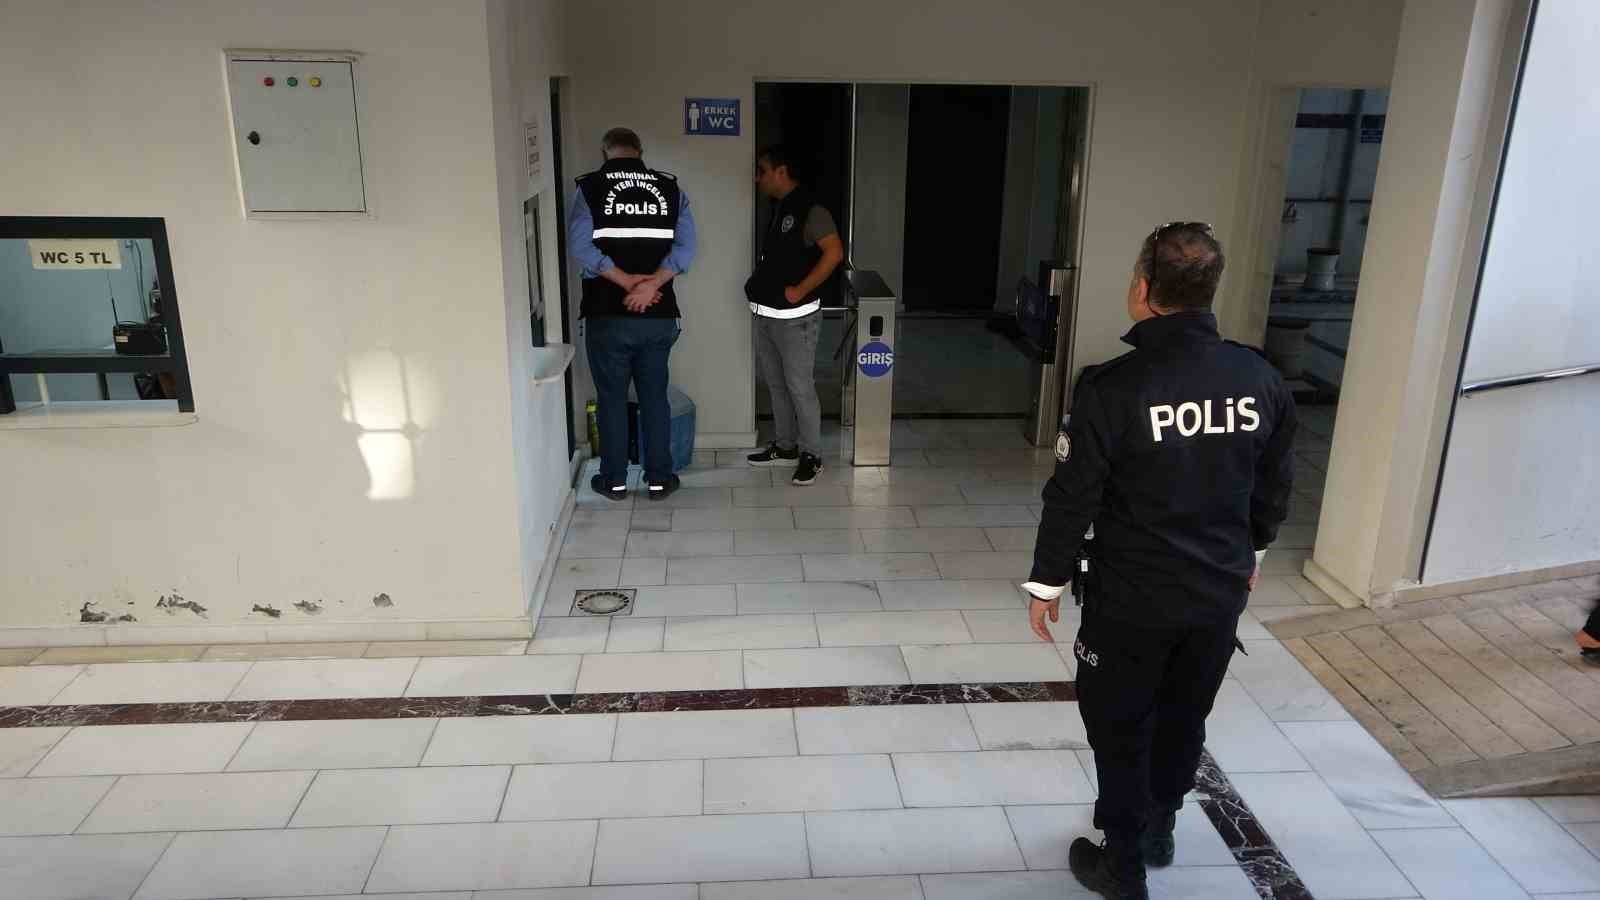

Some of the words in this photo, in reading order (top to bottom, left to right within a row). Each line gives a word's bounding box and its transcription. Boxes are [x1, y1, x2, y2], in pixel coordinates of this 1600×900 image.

[708, 116, 734, 129] WC
[604, 190, 617, 216] OLAY
[40, 251, 69, 264] WC
[74, 252, 85, 265] 5
[89, 252, 112, 265] TL
